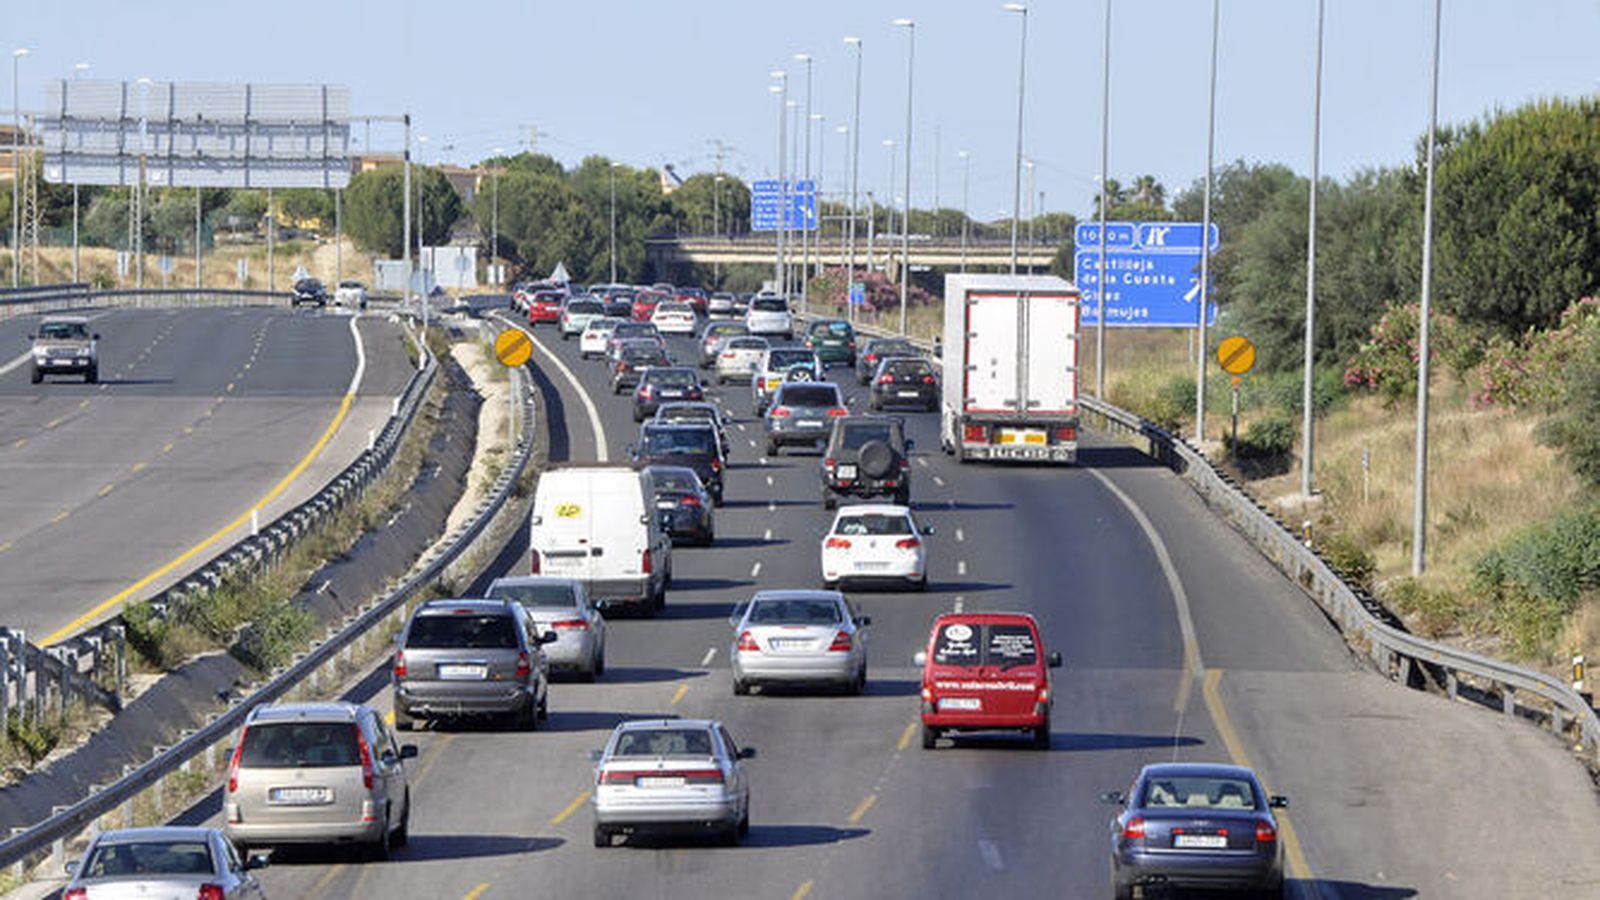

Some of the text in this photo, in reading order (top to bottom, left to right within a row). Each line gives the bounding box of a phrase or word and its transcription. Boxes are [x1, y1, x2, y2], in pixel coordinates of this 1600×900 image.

[1123, 272, 1176, 285] Cuesta
[1081, 289, 1121, 302] Gies
[1081, 304, 1149, 320] Bomujos
